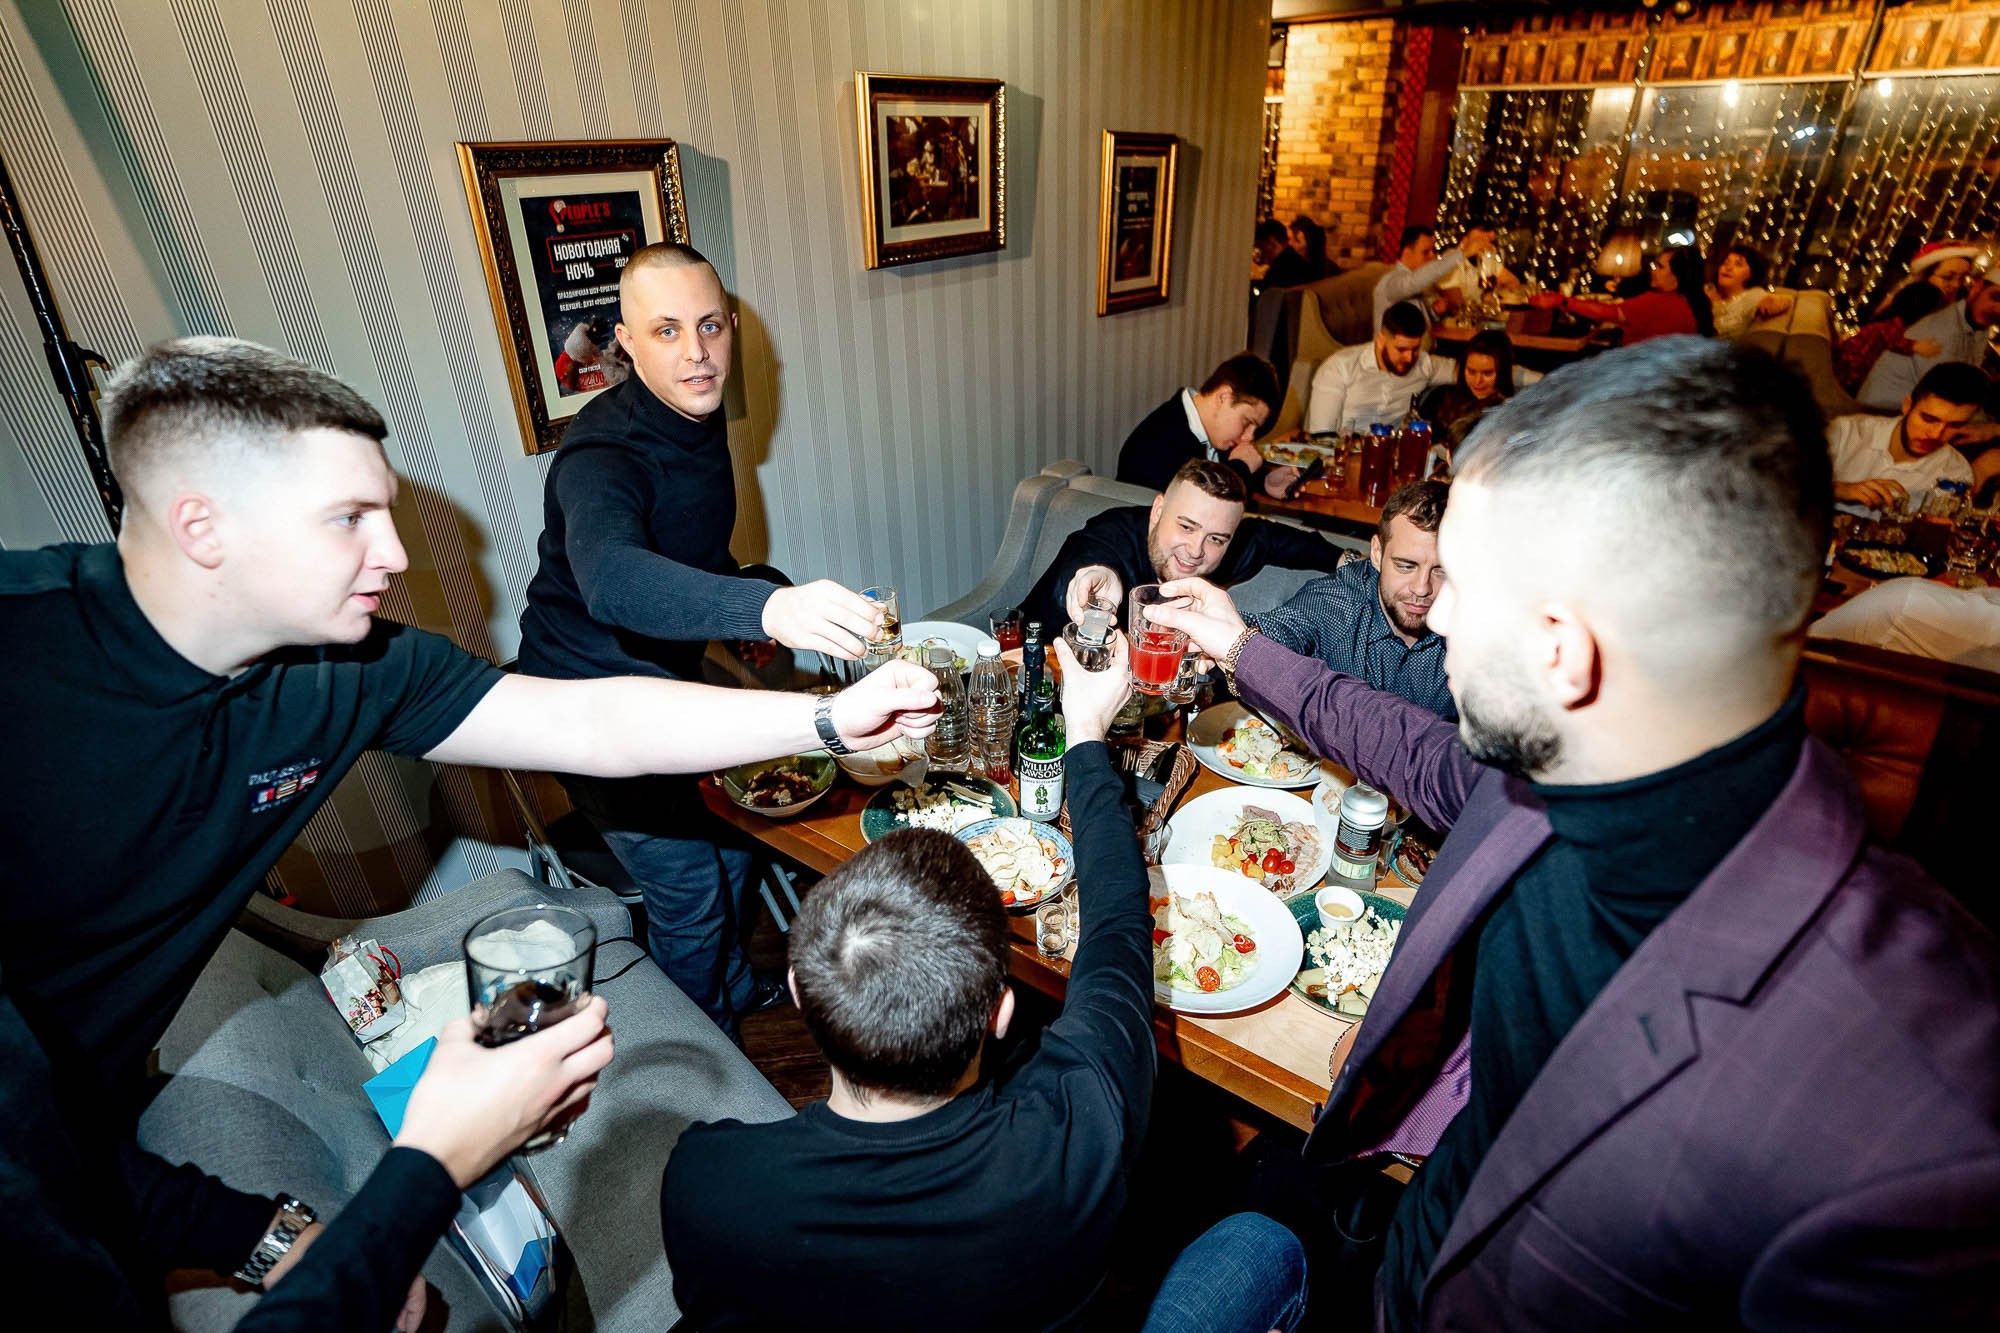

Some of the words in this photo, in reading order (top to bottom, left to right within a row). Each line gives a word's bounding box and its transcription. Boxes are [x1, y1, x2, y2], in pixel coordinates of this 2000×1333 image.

[553, 238, 621, 261] НОВОГОДНЯЯ
[565, 261, 595, 281] НОЧЬ
[1022, 759, 1062, 772] WILLIAM
